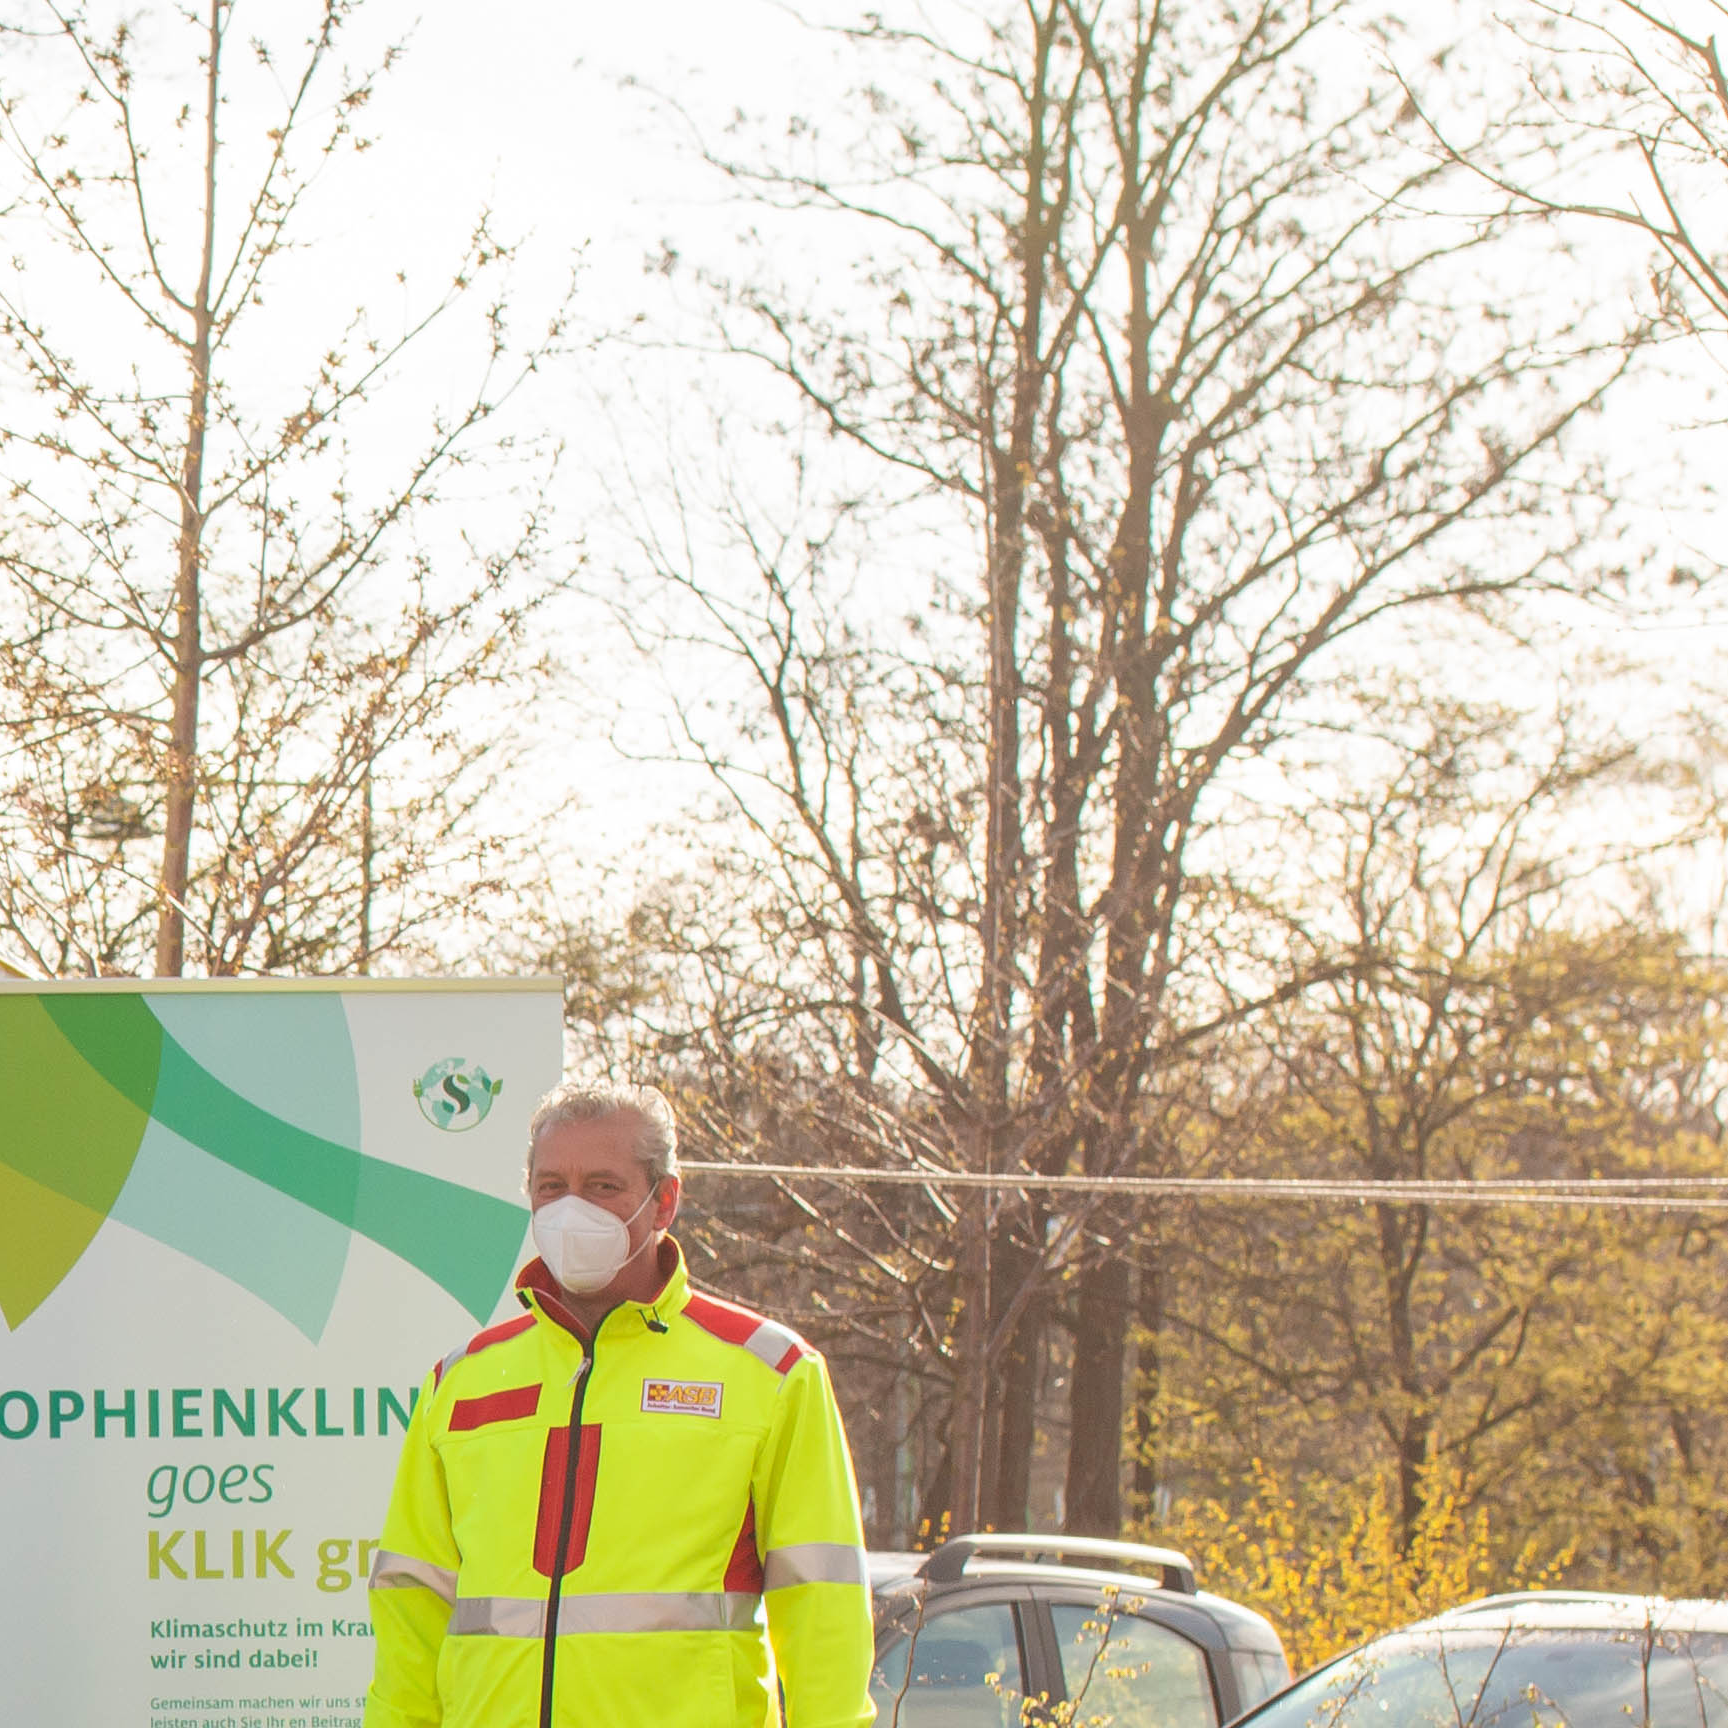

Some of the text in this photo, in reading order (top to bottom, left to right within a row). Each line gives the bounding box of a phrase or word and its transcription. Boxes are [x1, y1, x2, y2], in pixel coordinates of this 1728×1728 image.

[665, 1384, 719, 1406] ASB
[146, 1463, 275, 1519] goes
[147, 1528, 296, 1581] KLIK
[150, 1617, 288, 1639] Klimaschutz
[295, 1617, 324, 1638] im
[150, 1648, 319, 1670] wir sind dabei!
[150, 1696, 235, 1711] Gemeinsam
[238, 1695, 295, 1710] machen
[299, 1695, 322, 1709] wir
[325, 1697, 351, 1709] uns
[201, 1715, 237, 1728] auch
[240, 1715, 261, 1728] Sie
